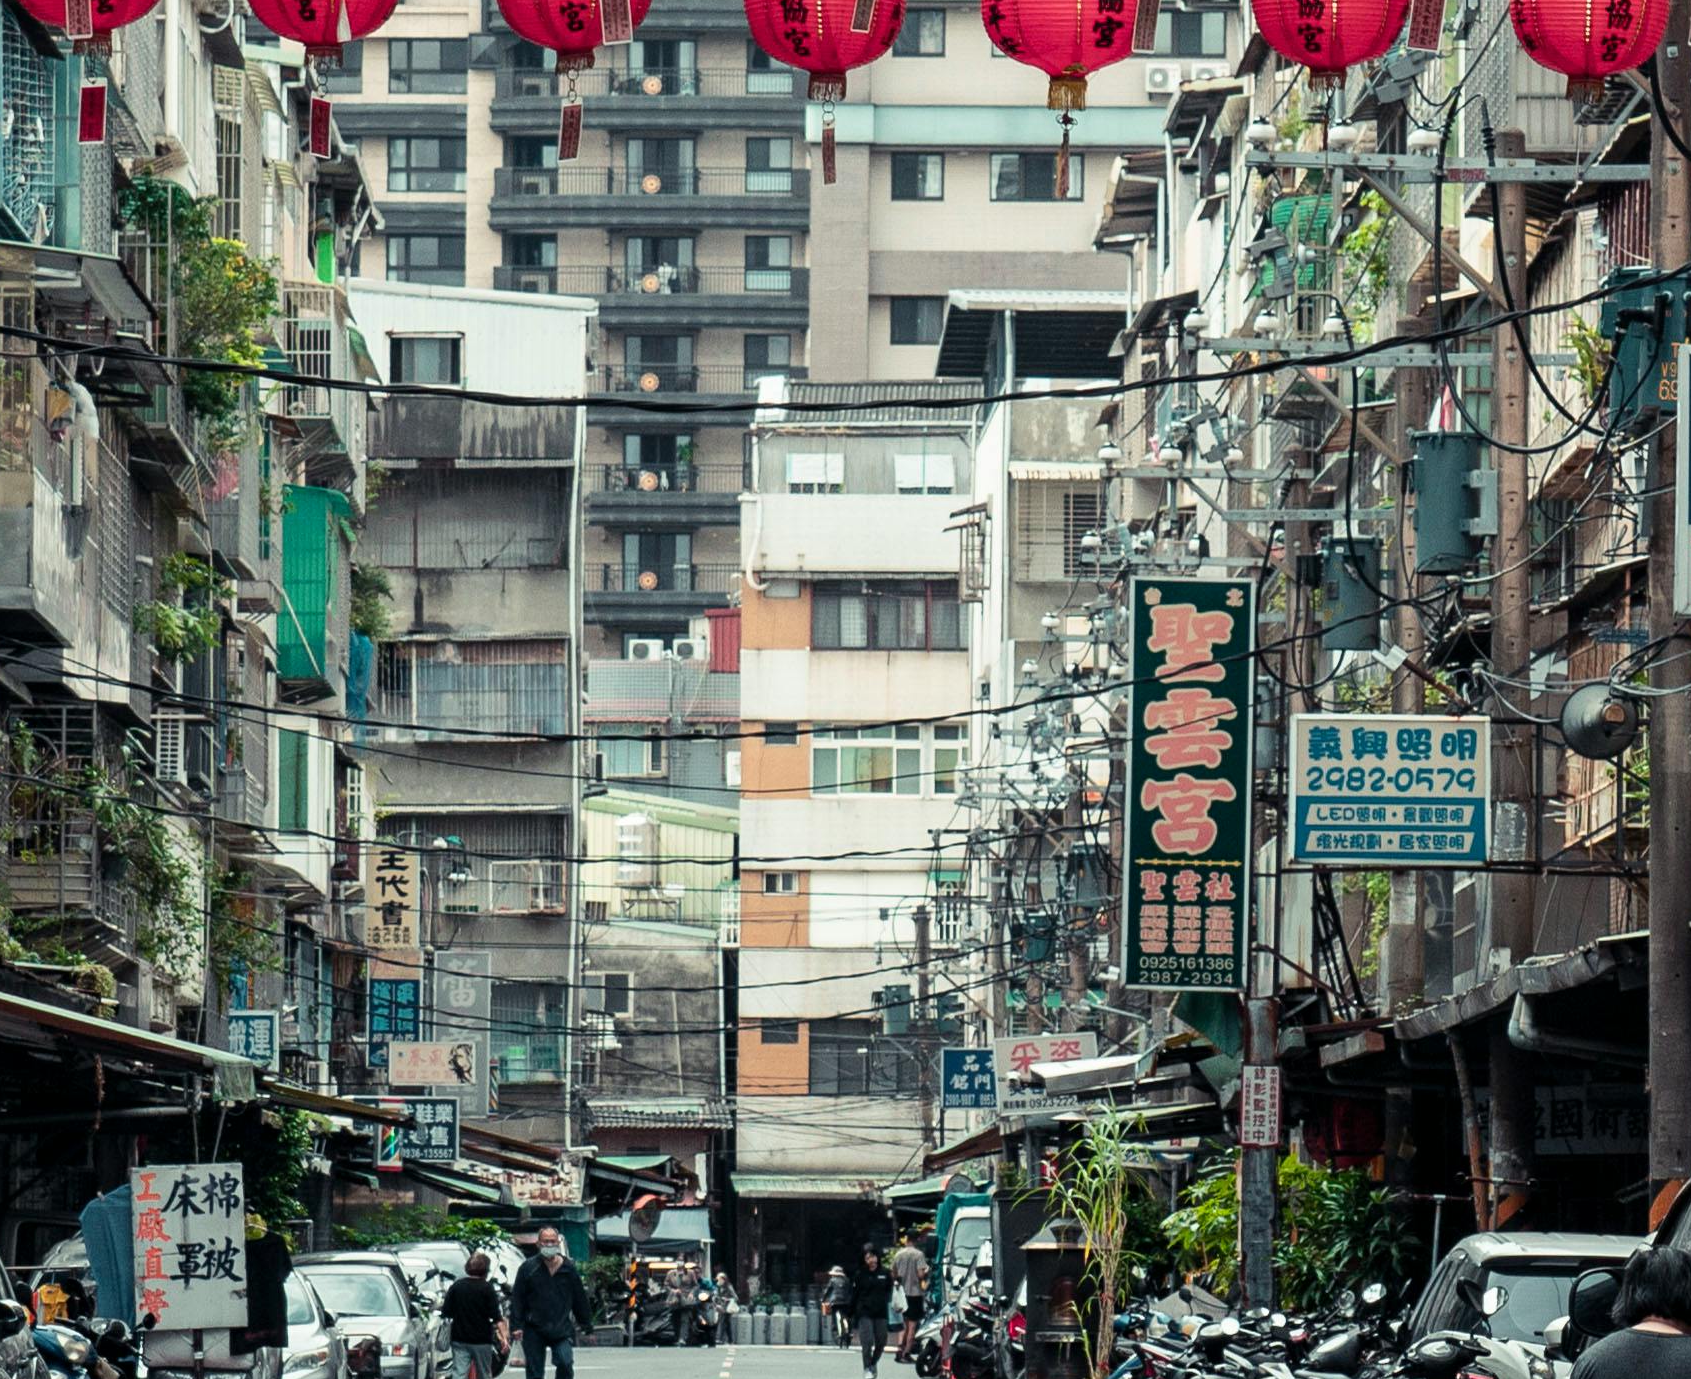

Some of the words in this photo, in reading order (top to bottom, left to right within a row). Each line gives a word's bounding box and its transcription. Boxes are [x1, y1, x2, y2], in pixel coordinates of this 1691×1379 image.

[1138, 603, 1239, 855] 聖雲宮
[1308, 725, 1478, 761] 義興照明
[1306, 766, 1476, 792] 2982-0579
[1140, 870, 1236, 901] 聖雲社
[1139, 956, 1235, 970] 0925161386
[1139, 971, 1233, 984] 2987-2934
